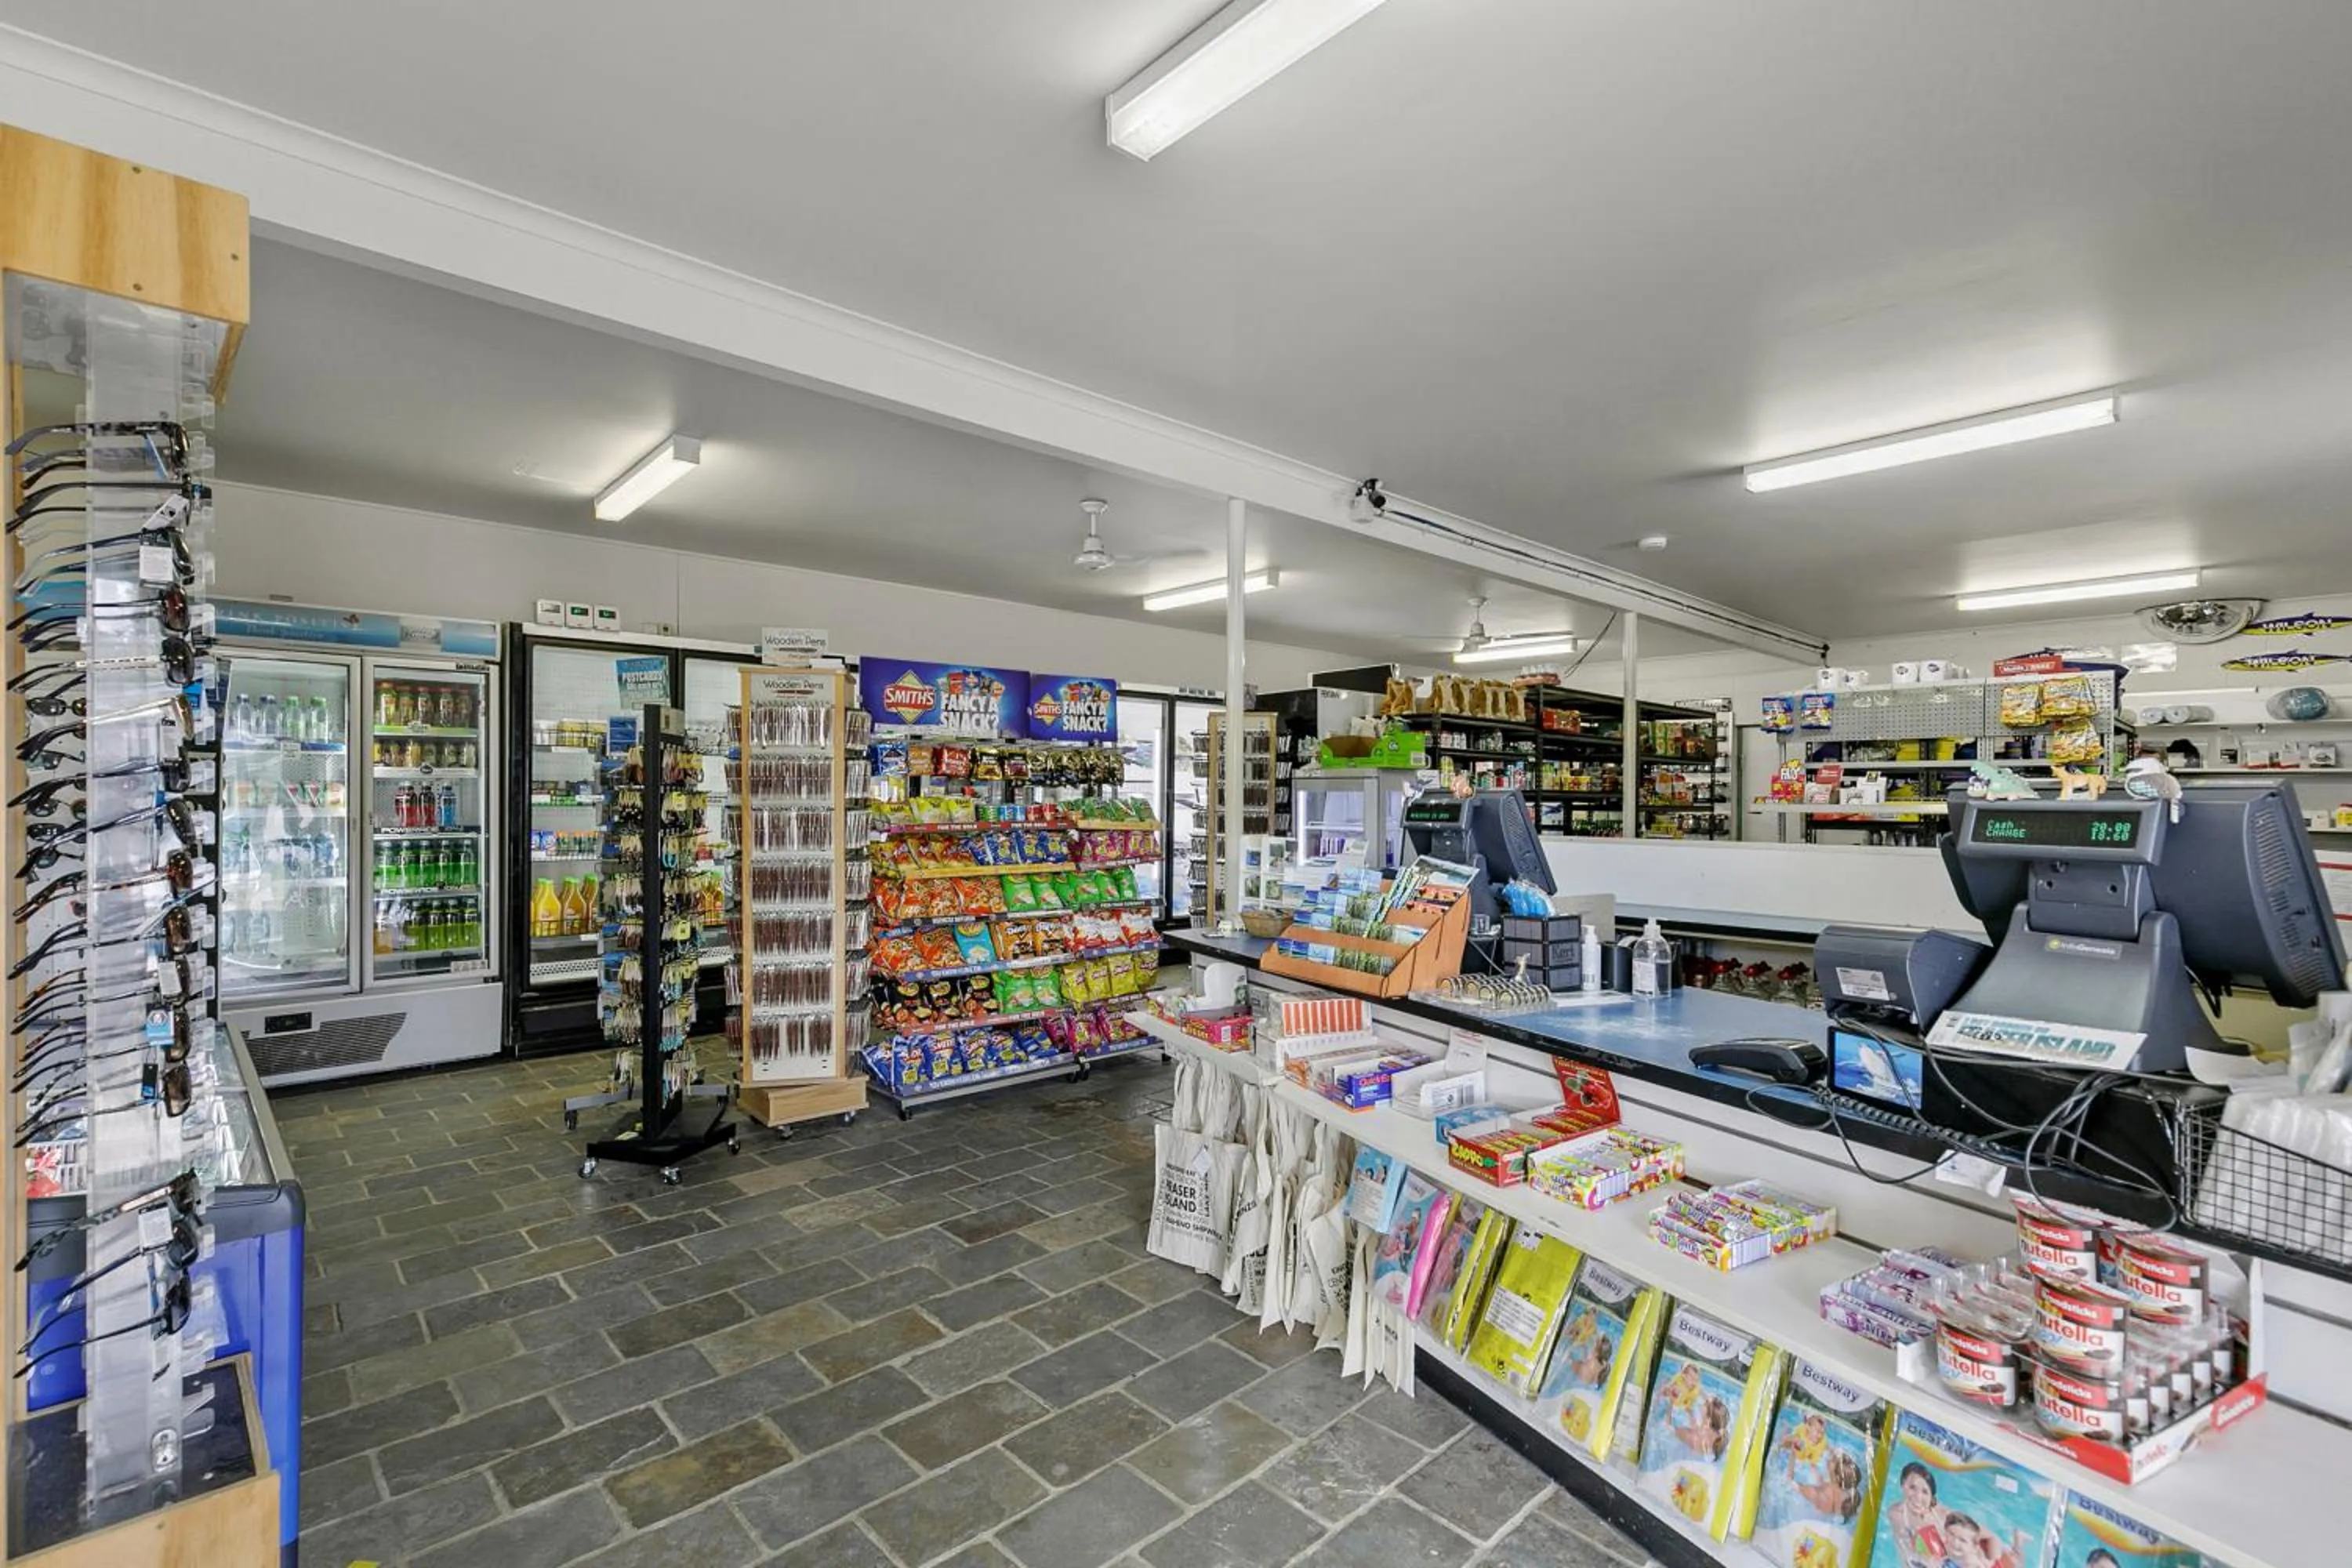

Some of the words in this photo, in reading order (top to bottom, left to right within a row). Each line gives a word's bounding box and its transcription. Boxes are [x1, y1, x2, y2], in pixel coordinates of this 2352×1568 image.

[2263, 619, 2332, 632] WILSON
[764, 635, 802, 646] Wooden
[805, 635, 827, 646] Pens
[2248, 656, 2314, 668] WILSON
[762, 679, 801, 689] Wooden
[804, 680, 824, 689] Pens
[885, 688, 935, 706] SMITH'S
[941, 692, 986, 713] FANCY
[988, 695, 999, 713] A
[1063, 700, 1098, 716] FANCY
[1098, 702, 1106, 716] A
[941, 711, 1000, 733] SNACK?
[1063, 714, 1107, 734] SNACK?
[1986, 828, 2027, 838] CHANGE
[1987, 820, 2014, 829] Cash
[1588, 1268, 1624, 1296] Bestway
[1678, 1319, 1732, 1353] Bestway
[1803, 1365, 1860, 1403] Bestway
[2079, 1497, 2158, 1545] Bestway
